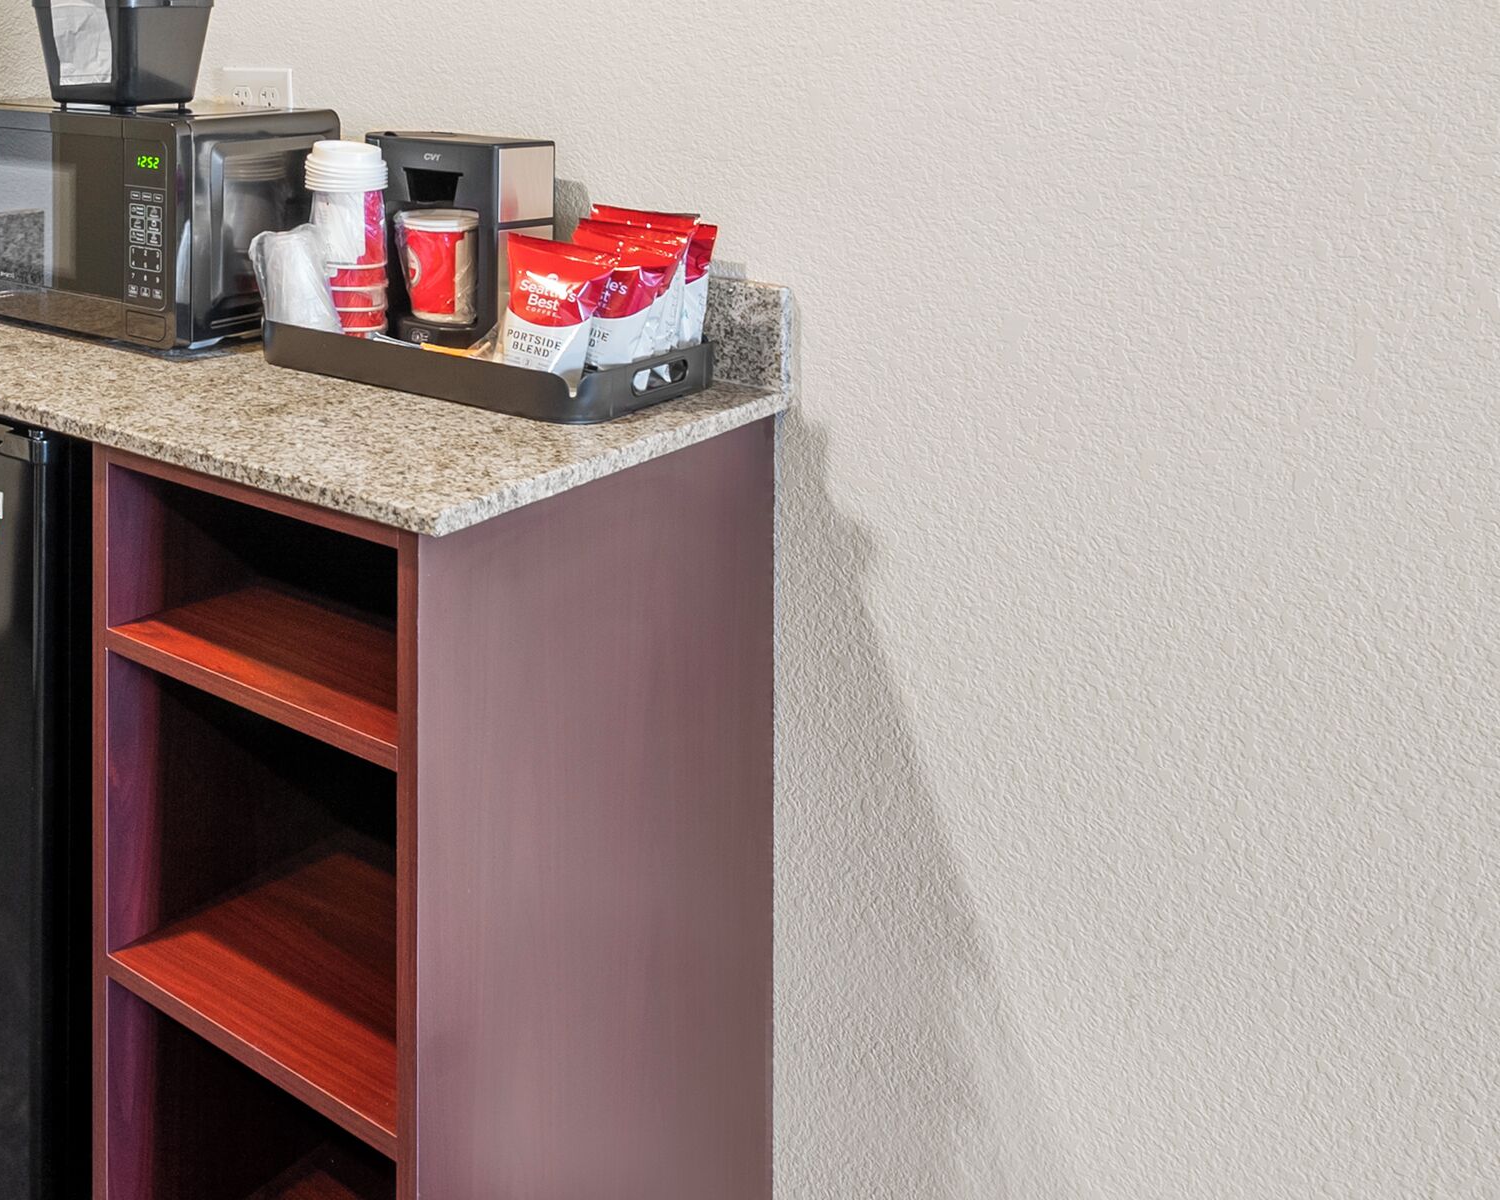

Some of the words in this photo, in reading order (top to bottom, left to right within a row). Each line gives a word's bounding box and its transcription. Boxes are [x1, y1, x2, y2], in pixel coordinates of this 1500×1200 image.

[519, 279, 577, 303] Sea's
[527, 293, 560, 312] Best
[506, 328, 562, 351] PORTSIDE
[512, 340, 550, 358] BLEND
